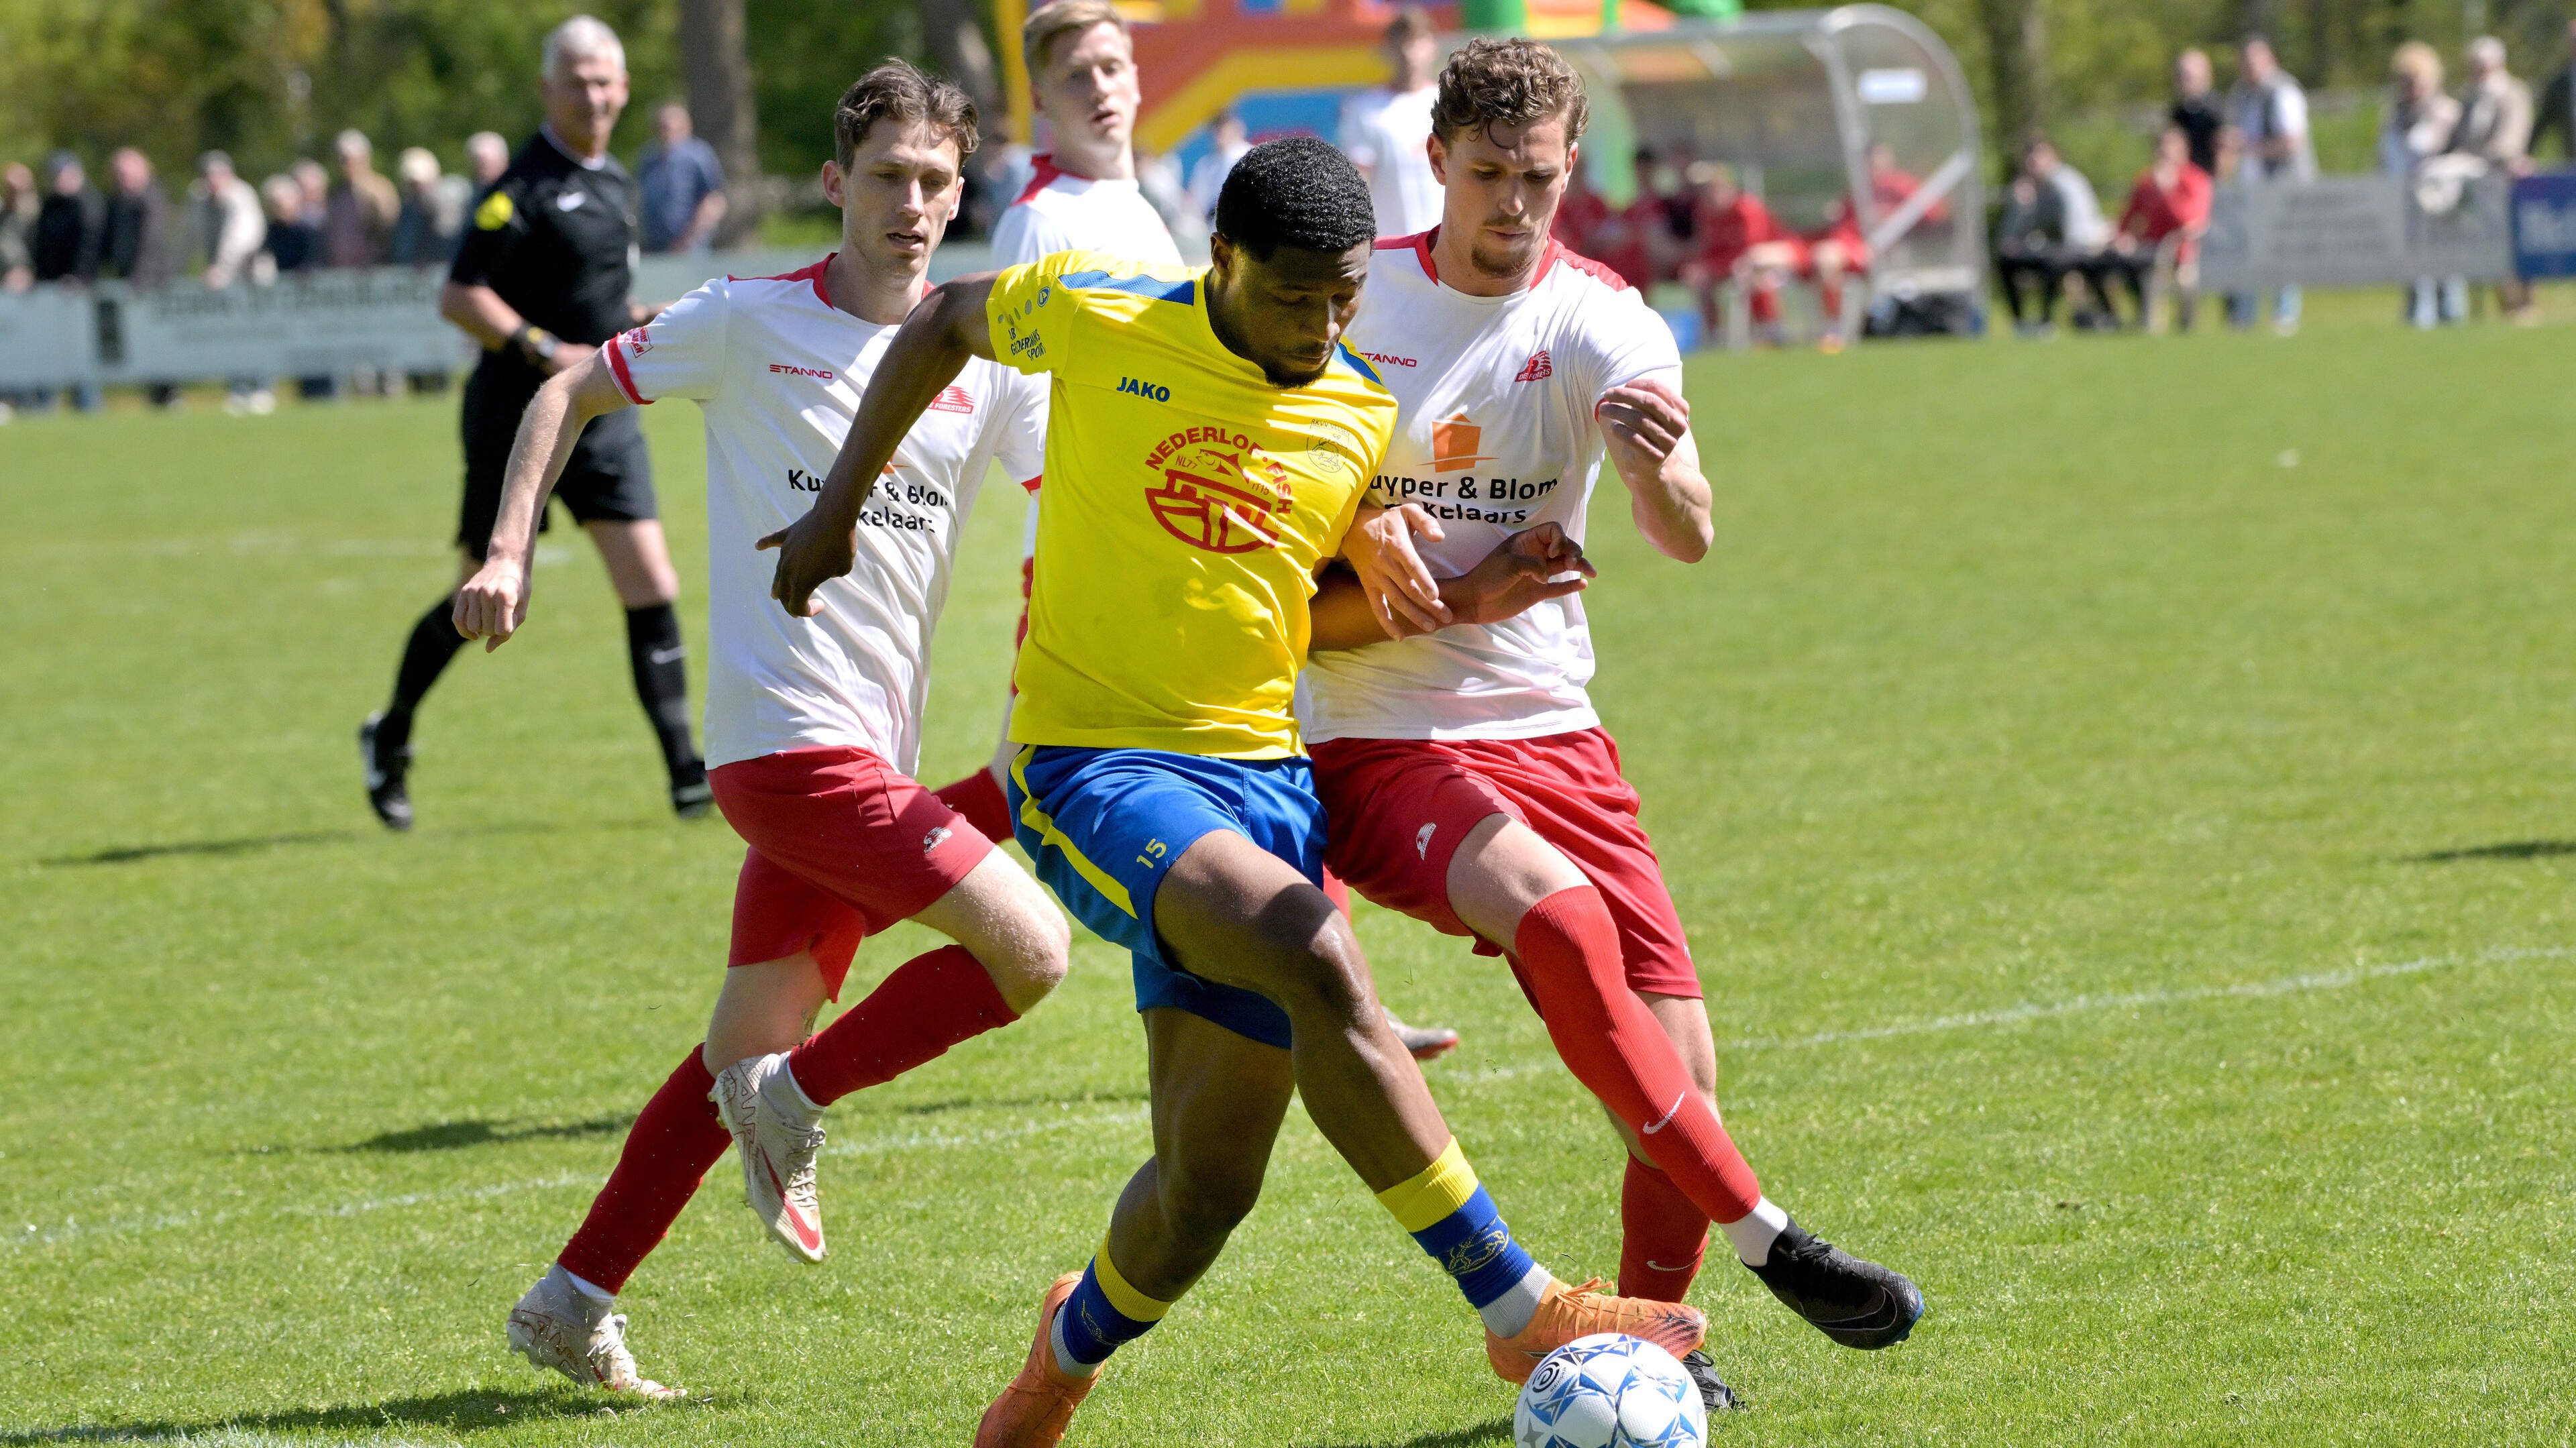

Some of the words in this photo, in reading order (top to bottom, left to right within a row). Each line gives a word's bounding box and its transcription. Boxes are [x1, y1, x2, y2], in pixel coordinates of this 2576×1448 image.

[769, 364, 833, 380] STANNO
[1116, 376, 1171, 402] JAKO
[934, 403, 972, 412] FORESTERS
[1175, 455, 1197, 469] NL77
[885, 482, 900, 502] &
[1265, 461, 1293, 514] FISH
[1369, 474, 1449, 498] uyper
[1458, 476, 1479, 499] &
[1489, 478, 1558, 500] Blom
[1136, 838, 1167, 869] 15
